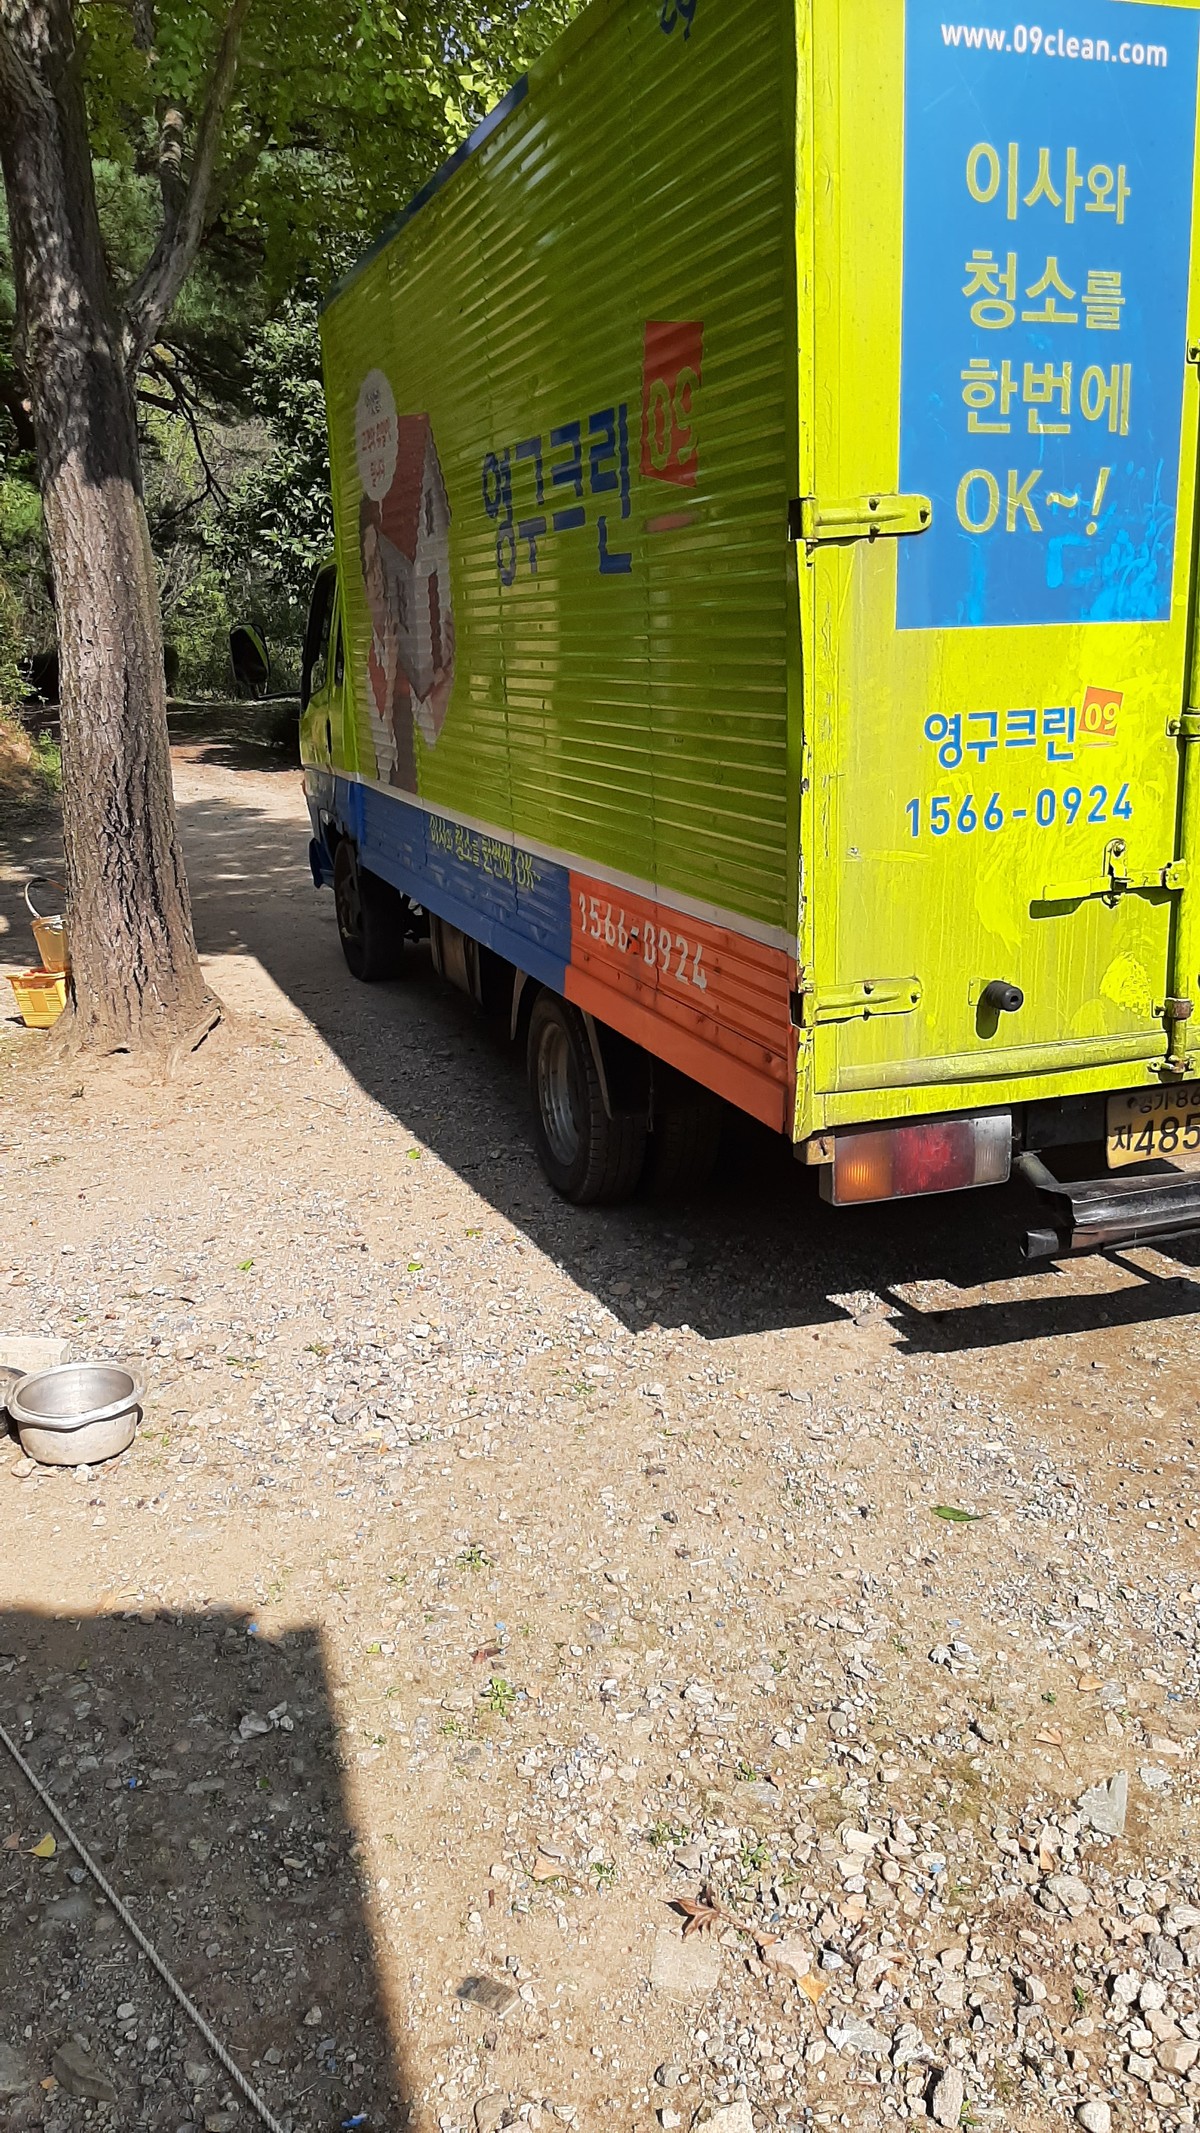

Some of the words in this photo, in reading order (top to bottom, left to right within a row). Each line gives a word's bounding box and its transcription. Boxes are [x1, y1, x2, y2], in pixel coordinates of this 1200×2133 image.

[941, 23, 1169, 68] www.09clean.com
[964, 142, 1131, 224] 이사와
[961, 249, 1126, 330] 청소를
[960, 358, 1132, 436] 한번에
[482, 402, 632, 586] 영구크린
[646, 366, 699, 471] 09
[955, 466, 1110, 536] OK~!
[924, 706, 1077, 769] 영구크린
[1084, 702, 1121, 731] 09
[904, 783, 1133, 838] 1566-0924
[578, 891, 708, 993] 1566-0924
